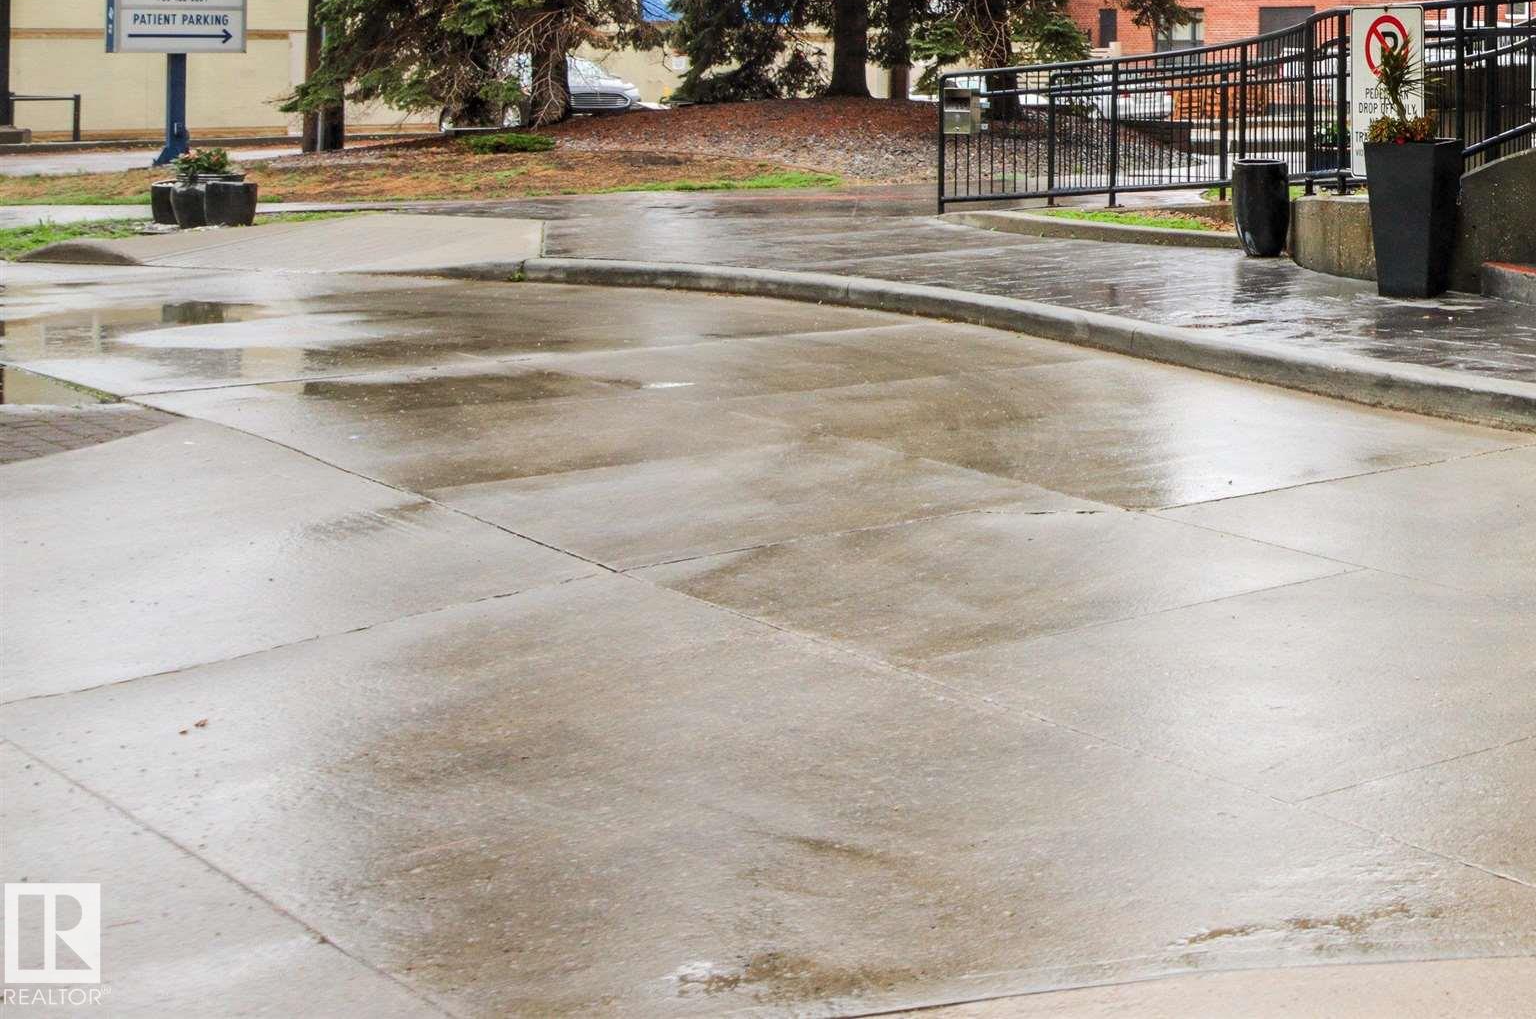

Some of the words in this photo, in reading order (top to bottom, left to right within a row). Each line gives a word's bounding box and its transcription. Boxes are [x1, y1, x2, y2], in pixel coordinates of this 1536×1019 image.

[133, 13, 176, 26] PATIENT
[182, 14, 229, 27] PARKING
[1358, 102, 1379, 115] DROP
